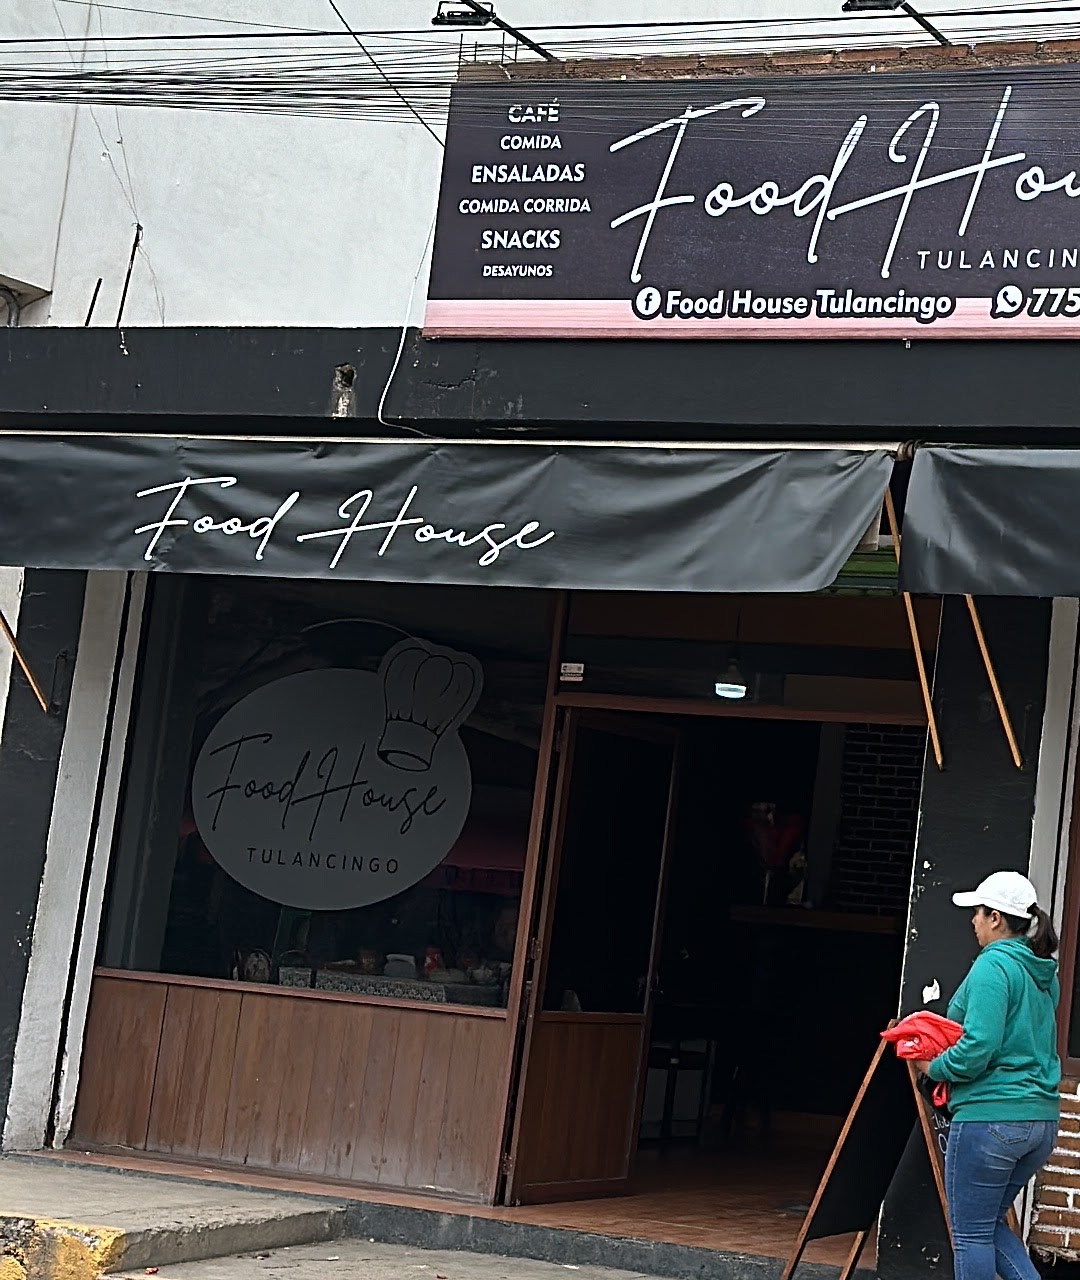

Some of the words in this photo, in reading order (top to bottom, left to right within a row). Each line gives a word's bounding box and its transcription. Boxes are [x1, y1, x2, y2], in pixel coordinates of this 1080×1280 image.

[508, 97, 561, 123] CAFÉ
[500, 134, 562, 150] COMIDA
[471, 163, 585, 183] ENSALADAS
[609, 96, 867, 284] Food
[458, 198, 520, 214] COMIDA
[523, 198, 592, 213] CORRIDA
[481, 229, 561, 249] SNACKS
[482, 264, 553, 277] DESAYUNOS
[665, 289, 724, 314] Food
[731, 289, 808, 314] House
[815, 288, 952, 319] Tulancingo
[134, 476, 300, 561] Food
[296, 485, 556, 569] House
[206, 732, 311, 832] Food
[290, 743, 447, 842] House
[246, 846, 400, 875] TULANCINGO
